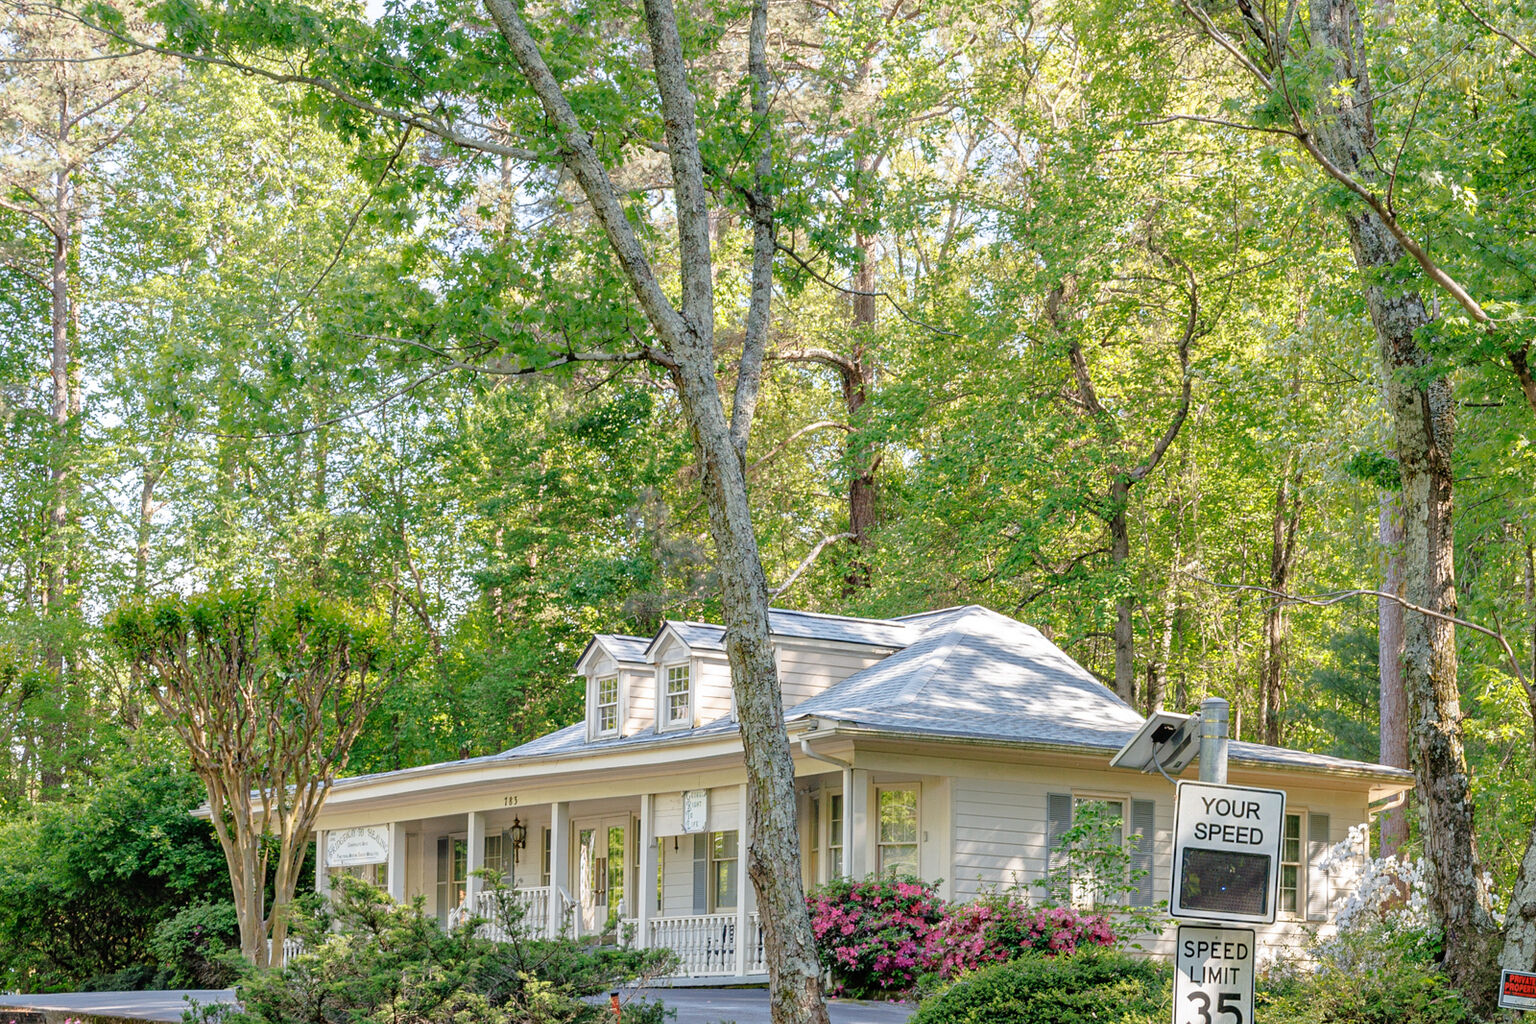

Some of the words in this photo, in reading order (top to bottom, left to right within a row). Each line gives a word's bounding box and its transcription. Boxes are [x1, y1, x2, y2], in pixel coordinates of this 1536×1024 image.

[1201, 796, 1261, 820] YOUR
[1193, 822, 1264, 845] SPEED
[1183, 940, 1248, 960] SPEED
[1190, 966, 1240, 985] LIMIT
[1509, 974, 1536, 986] PRIVATE
